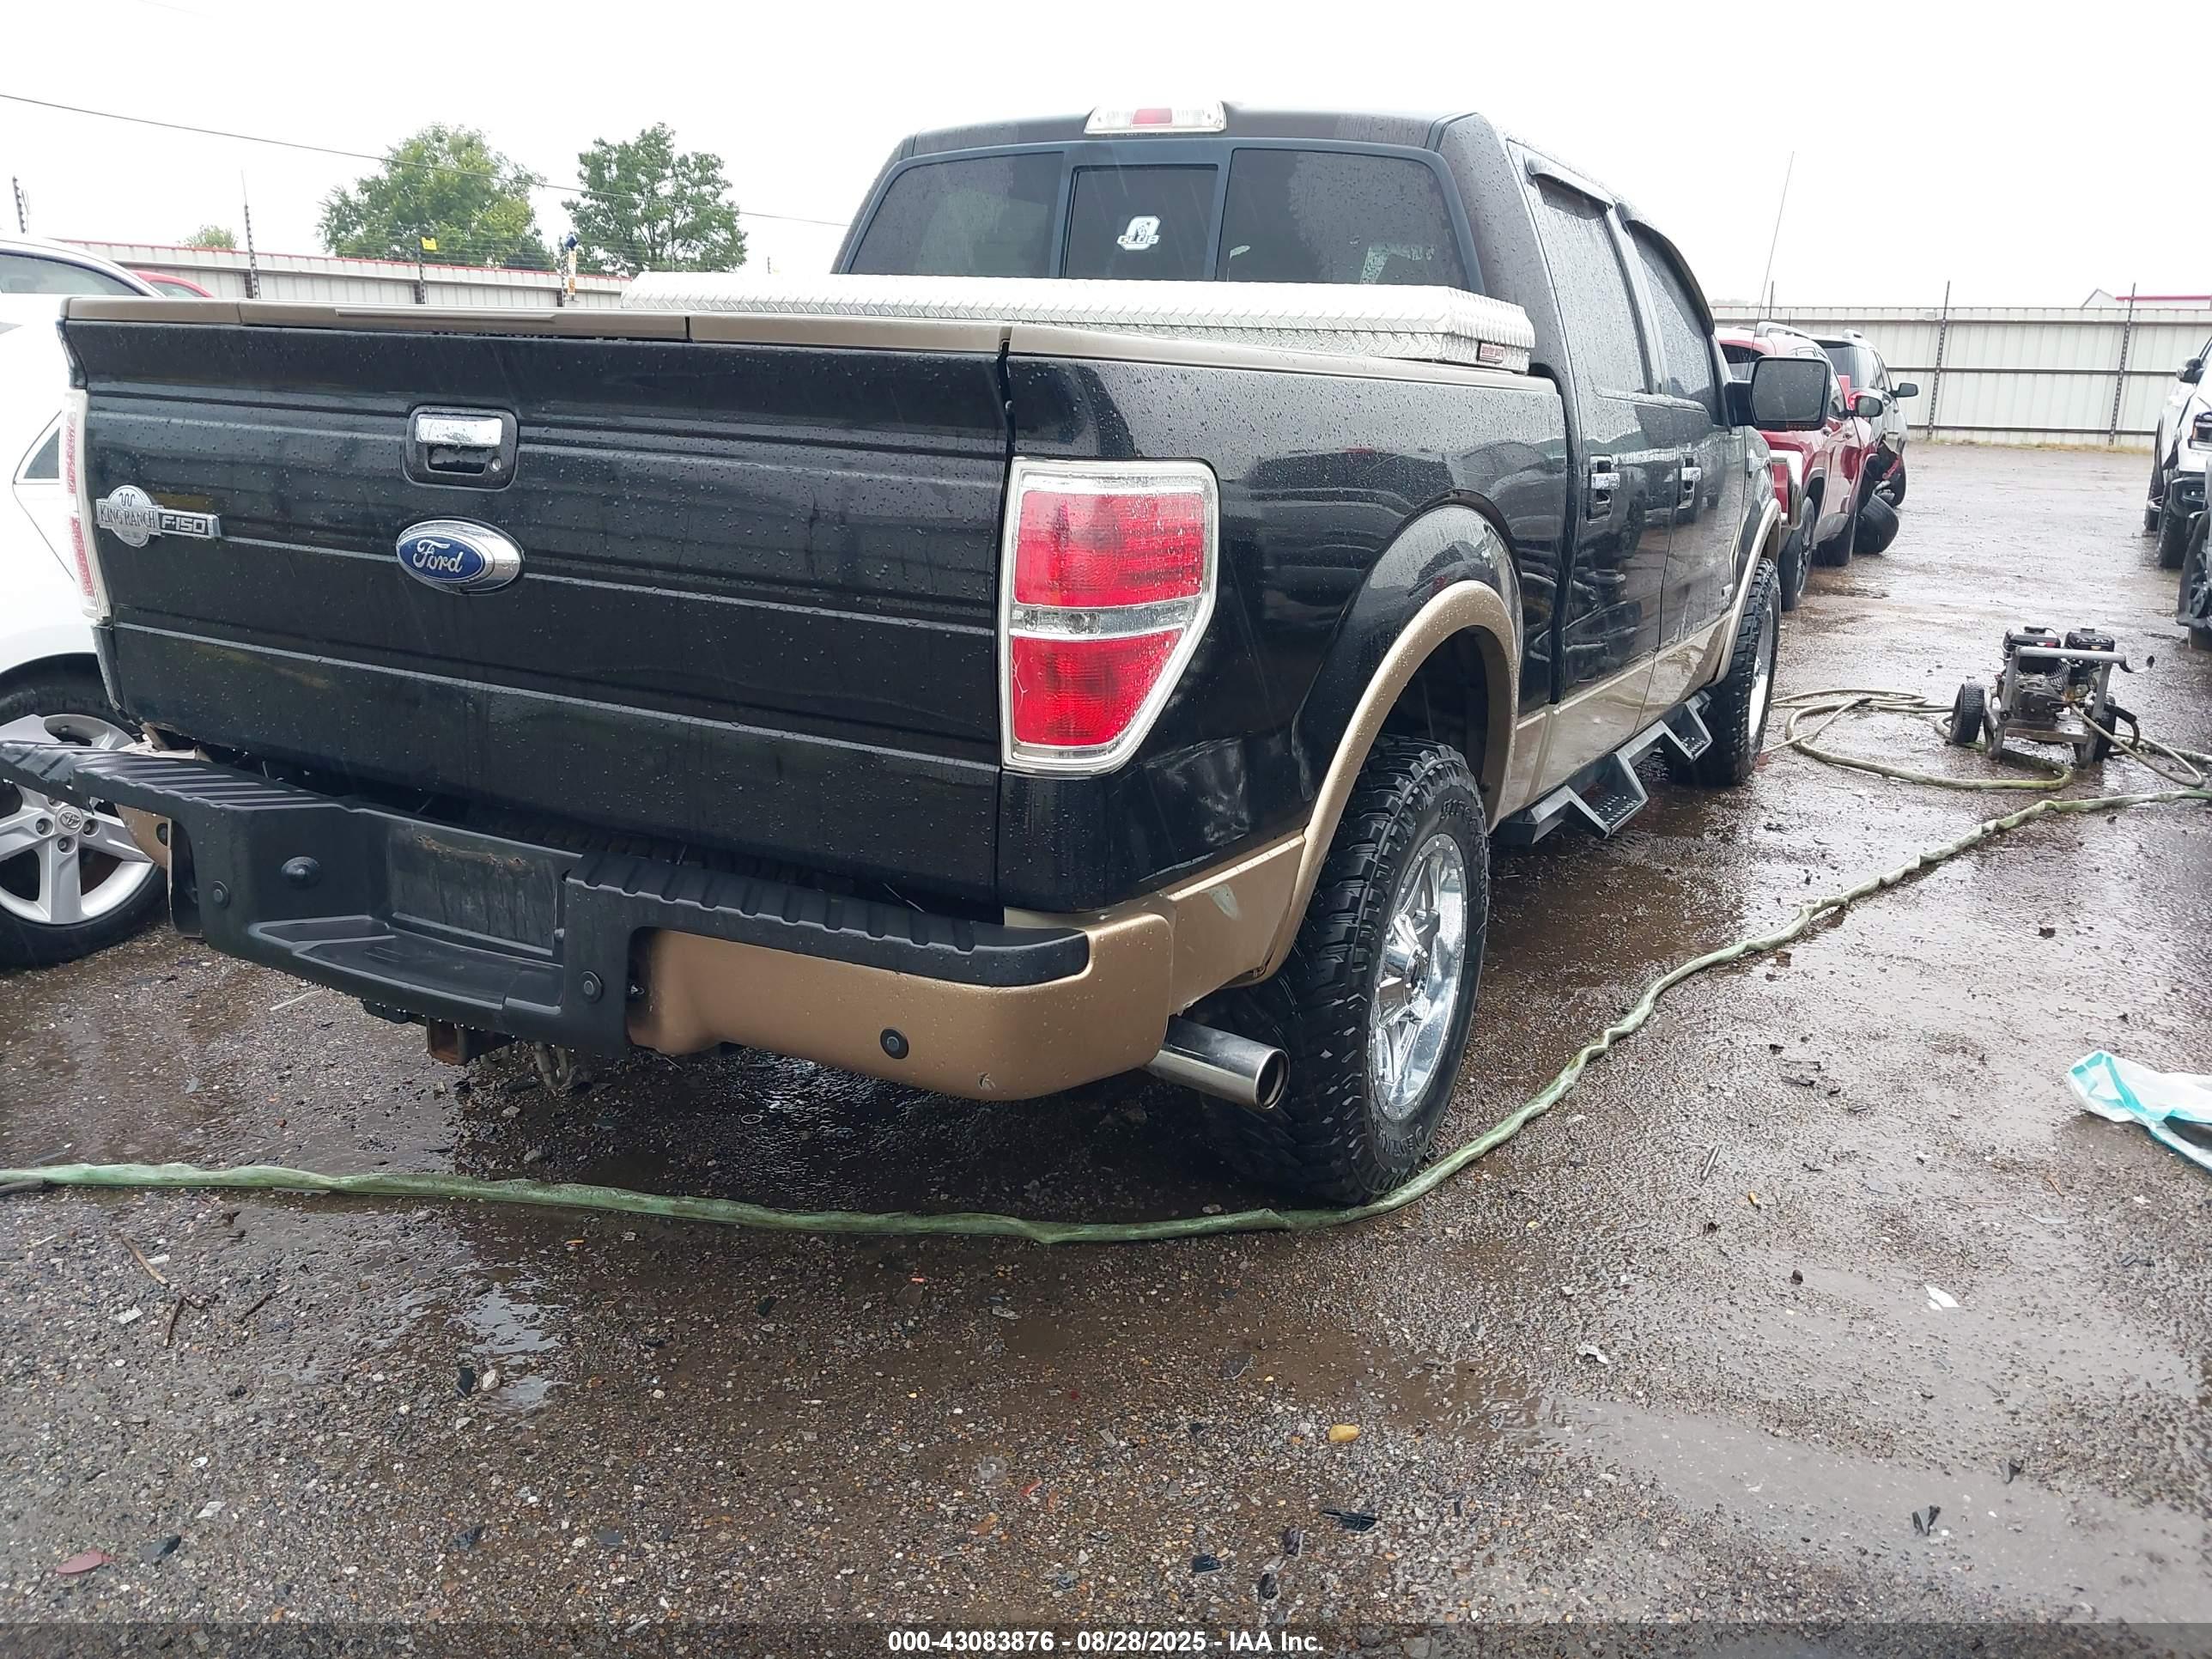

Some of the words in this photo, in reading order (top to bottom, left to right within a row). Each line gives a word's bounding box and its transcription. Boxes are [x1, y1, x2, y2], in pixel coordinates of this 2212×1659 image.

[100, 505, 123, 525] KING
[125, 510, 156, 528] RANCH
[413, 539, 463, 573] Ford
